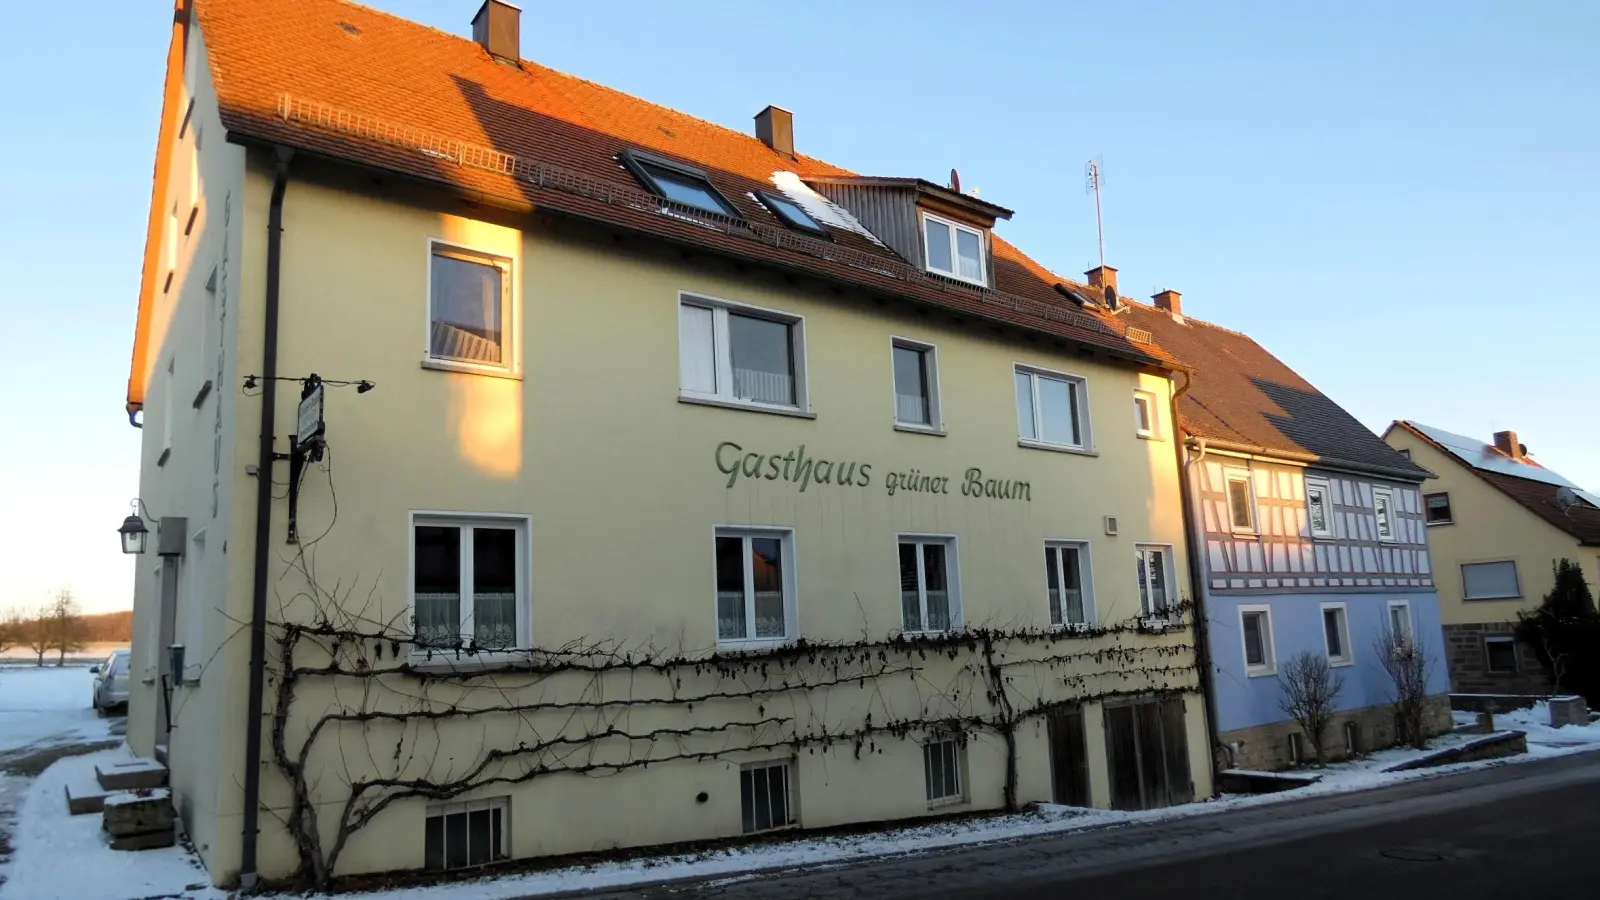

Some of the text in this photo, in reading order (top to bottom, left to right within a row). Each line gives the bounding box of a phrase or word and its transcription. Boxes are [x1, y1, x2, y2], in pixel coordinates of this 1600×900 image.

[715, 441, 1031, 501] Gasthaus grüner Baum
